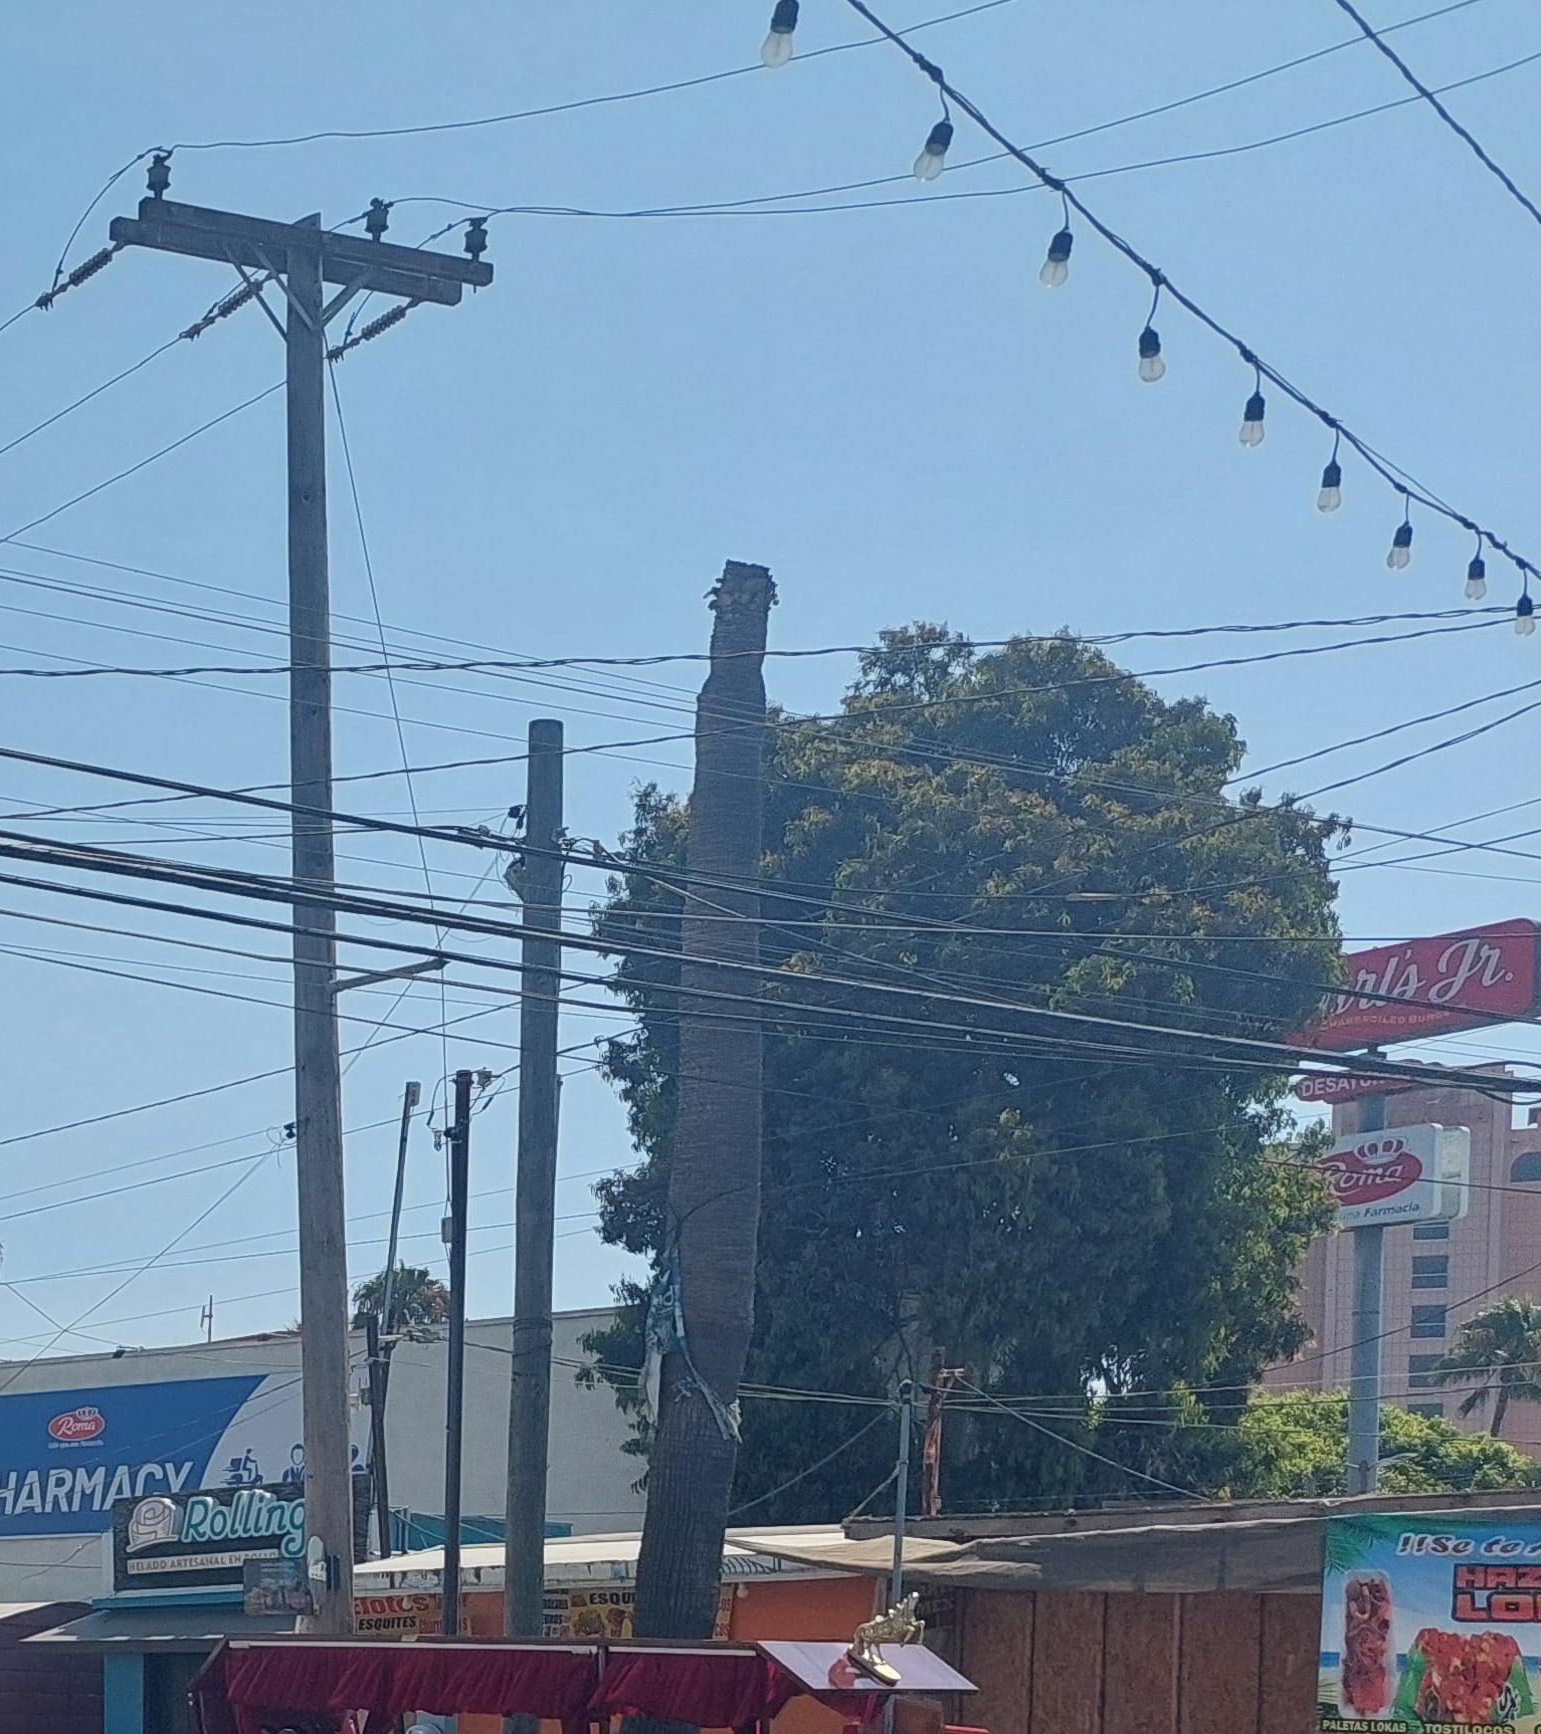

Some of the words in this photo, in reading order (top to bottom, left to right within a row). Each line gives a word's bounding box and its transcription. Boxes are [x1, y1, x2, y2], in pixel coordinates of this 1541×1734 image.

[1429, 939, 1514, 1004] Jr.
[57, 1416, 95, 1436] Roma
[181, 1489, 305, 1558] Rolling
[129, 1559, 167, 1573] HELADO
[170, 1556, 226, 1569] ARTESANAL
[228, 1555, 243, 1565] EN
[1452, 1591, 1541, 1623] LO
[358, 1616, 417, 1631] ESQUITES
[1322, 1720, 1367, 1732] PALETAS
[1370, 1722, 1407, 1734] LOKAS
